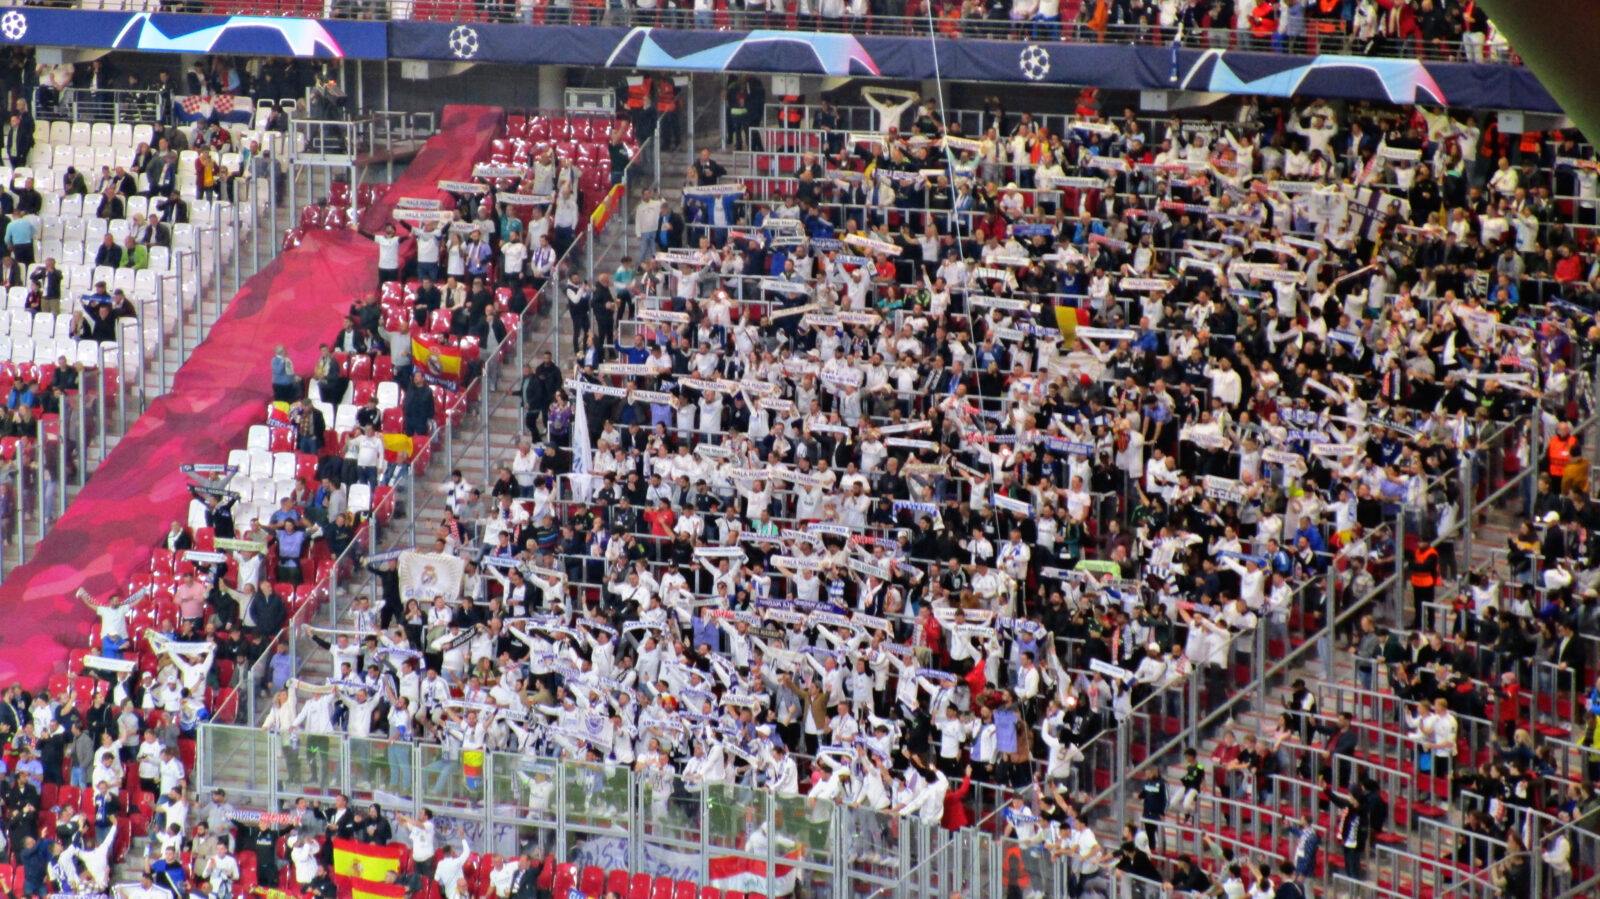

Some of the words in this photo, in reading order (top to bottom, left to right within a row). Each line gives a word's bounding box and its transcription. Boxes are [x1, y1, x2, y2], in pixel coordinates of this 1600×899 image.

[706, 381, 727, 389] MADRID
[649, 393, 671, 401] MADRID
[797, 475, 820, 484] MADRID
[797, 560, 819, 568] MADRID
